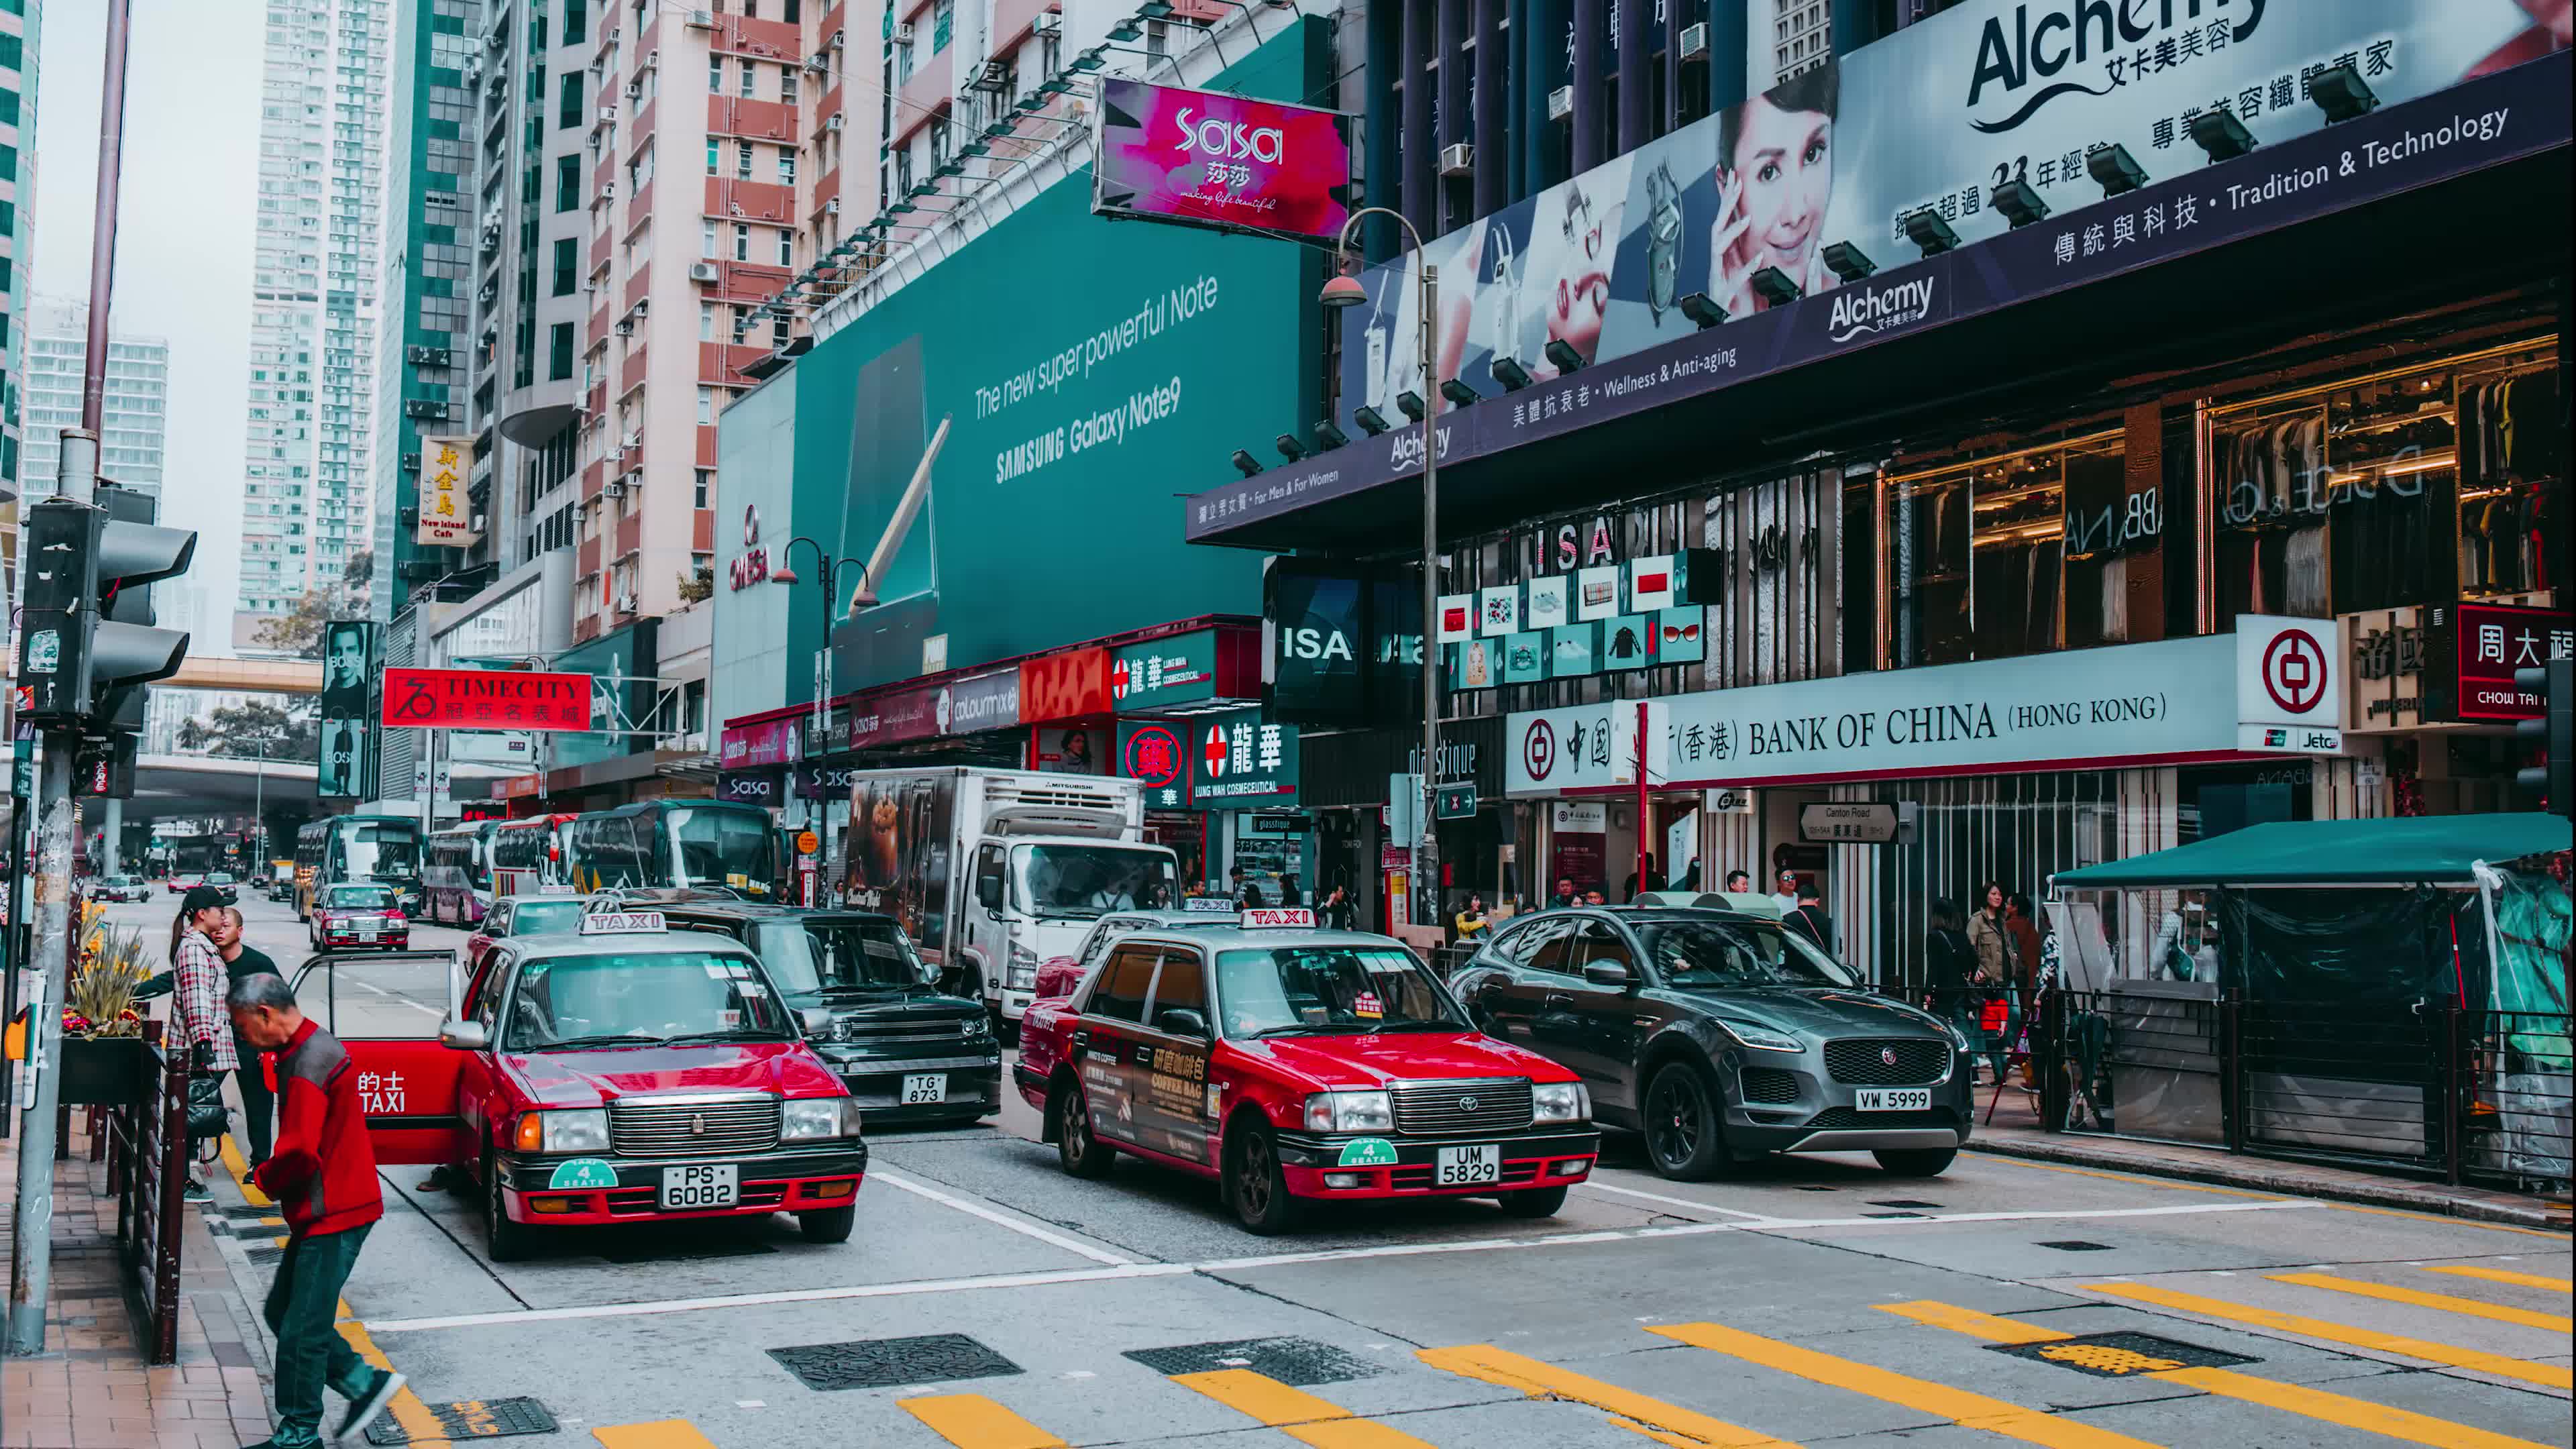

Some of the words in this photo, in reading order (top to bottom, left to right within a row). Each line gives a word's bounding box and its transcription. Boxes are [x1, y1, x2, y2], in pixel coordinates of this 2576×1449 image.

[2105, 17, 2231, 86] 艾卡美美容
[1175, 107, 1283, 165] Sasa
[1208, 161, 1250, 187] 莎莎
[2053, 194, 2199, 266] 傳統與科技
[2226, 162, 2329, 211] Tradition
[2340, 151, 2357, 176] &
[2362, 107, 2510, 169] Technology
[1181, 188, 1214, 206] making
[1216, 191, 1233, 208] life
[1235, 195, 1276, 213] beautiful
[1829, 276, 1934, 331] Alchemy
[975, 385, 1001, 420] The
[1003, 366, 1036, 408] new
[1038, 343, 1083, 394] super
[1085, 293, 1165, 380] powerful
[1170, 274, 1218, 327] Note
[1513, 384, 1590, 428] 美體抗衰老
[1604, 371, 1656, 398] Wellness
[1660, 364, 1670, 382] &
[1672, 347, 1737, 380] Anti-aging
[996, 426, 1065, 484] SAMSUNG
[1070, 405, 1128, 453] Galaxy
[1129, 375, 1181, 431] Note9
[1254, 491, 1267, 505] For
[1268, 485, 1285, 501] Men
[1286, 481, 1293, 495] &
[1294, 478, 1308, 493] For
[1307, 470, 1339, 488] Women
[421, 519, 439, 527] New
[441, 520, 466, 529] Island
[433, 529, 453, 538] Cafe
[1536, 516, 1613, 575] ISA
[730, 545, 771, 592] OMEGA
[1284, 627, 1352, 661] ISA
[2477, 625, 2573, 665] 周大福
[330, 655, 362, 668] BOSS
[1131, 655, 1163, 694] 龍華
[445, 678, 580, 699] TIMECITY
[2477, 692, 2514, 704] CHOW
[2518, 693, 2538, 706] TAI
[445, 702, 580, 722] 冠亞名表城
[1749, 716, 1829, 756] BANK
[1837, 711, 1876, 749] OF
[1886, 701, 1998, 745] CHINA
[2008, 702, 2082, 733] (HONG
[2090, 692, 2167, 722] KONG)
[1136, 737, 1173, 777] 藥
[1232, 722, 1282, 774] 龍華
[1409, 739, 1476, 782] glastique
[731, 778, 770, 795] Sasa
[1195, 785, 1211, 798] LUNG
[1212, 784, 1226, 796] WAH
[1226, 780, 1277, 796] COSMECEUTICAL
[1825, 807, 1850, 818] Canton
[1851, 807, 1870, 818] Road
[1834, 824, 1862, 838] 廣東道
[1192, 900, 1230, 910] TAXI
[590, 914, 660, 930] TAXI
[1251, 910, 1309, 924] TAXI
[358, 1070, 405, 1091] 的士
[916, 1075, 937, 1089] TG
[1151, 1073, 1182, 1094] COFFEE
[1183, 1082, 1203, 1099] BAG
[360, 1092, 405, 1114] TAXI
[910, 1089, 939, 1102] 873
[1860, 1091, 1882, 1109] VW
[1887, 1091, 1928, 1108] 5999
[1351, 1156, 1386, 1164] SEATS
[1362, 1144, 1375, 1157] 4
[1456, 1146, 1482, 1164] UM
[578, 1166, 591, 1179] 4
[685, 1166, 714, 1185] PS
[1443, 1164, 1495, 1183] 5829
[669, 1185, 731, 1205] 6082
